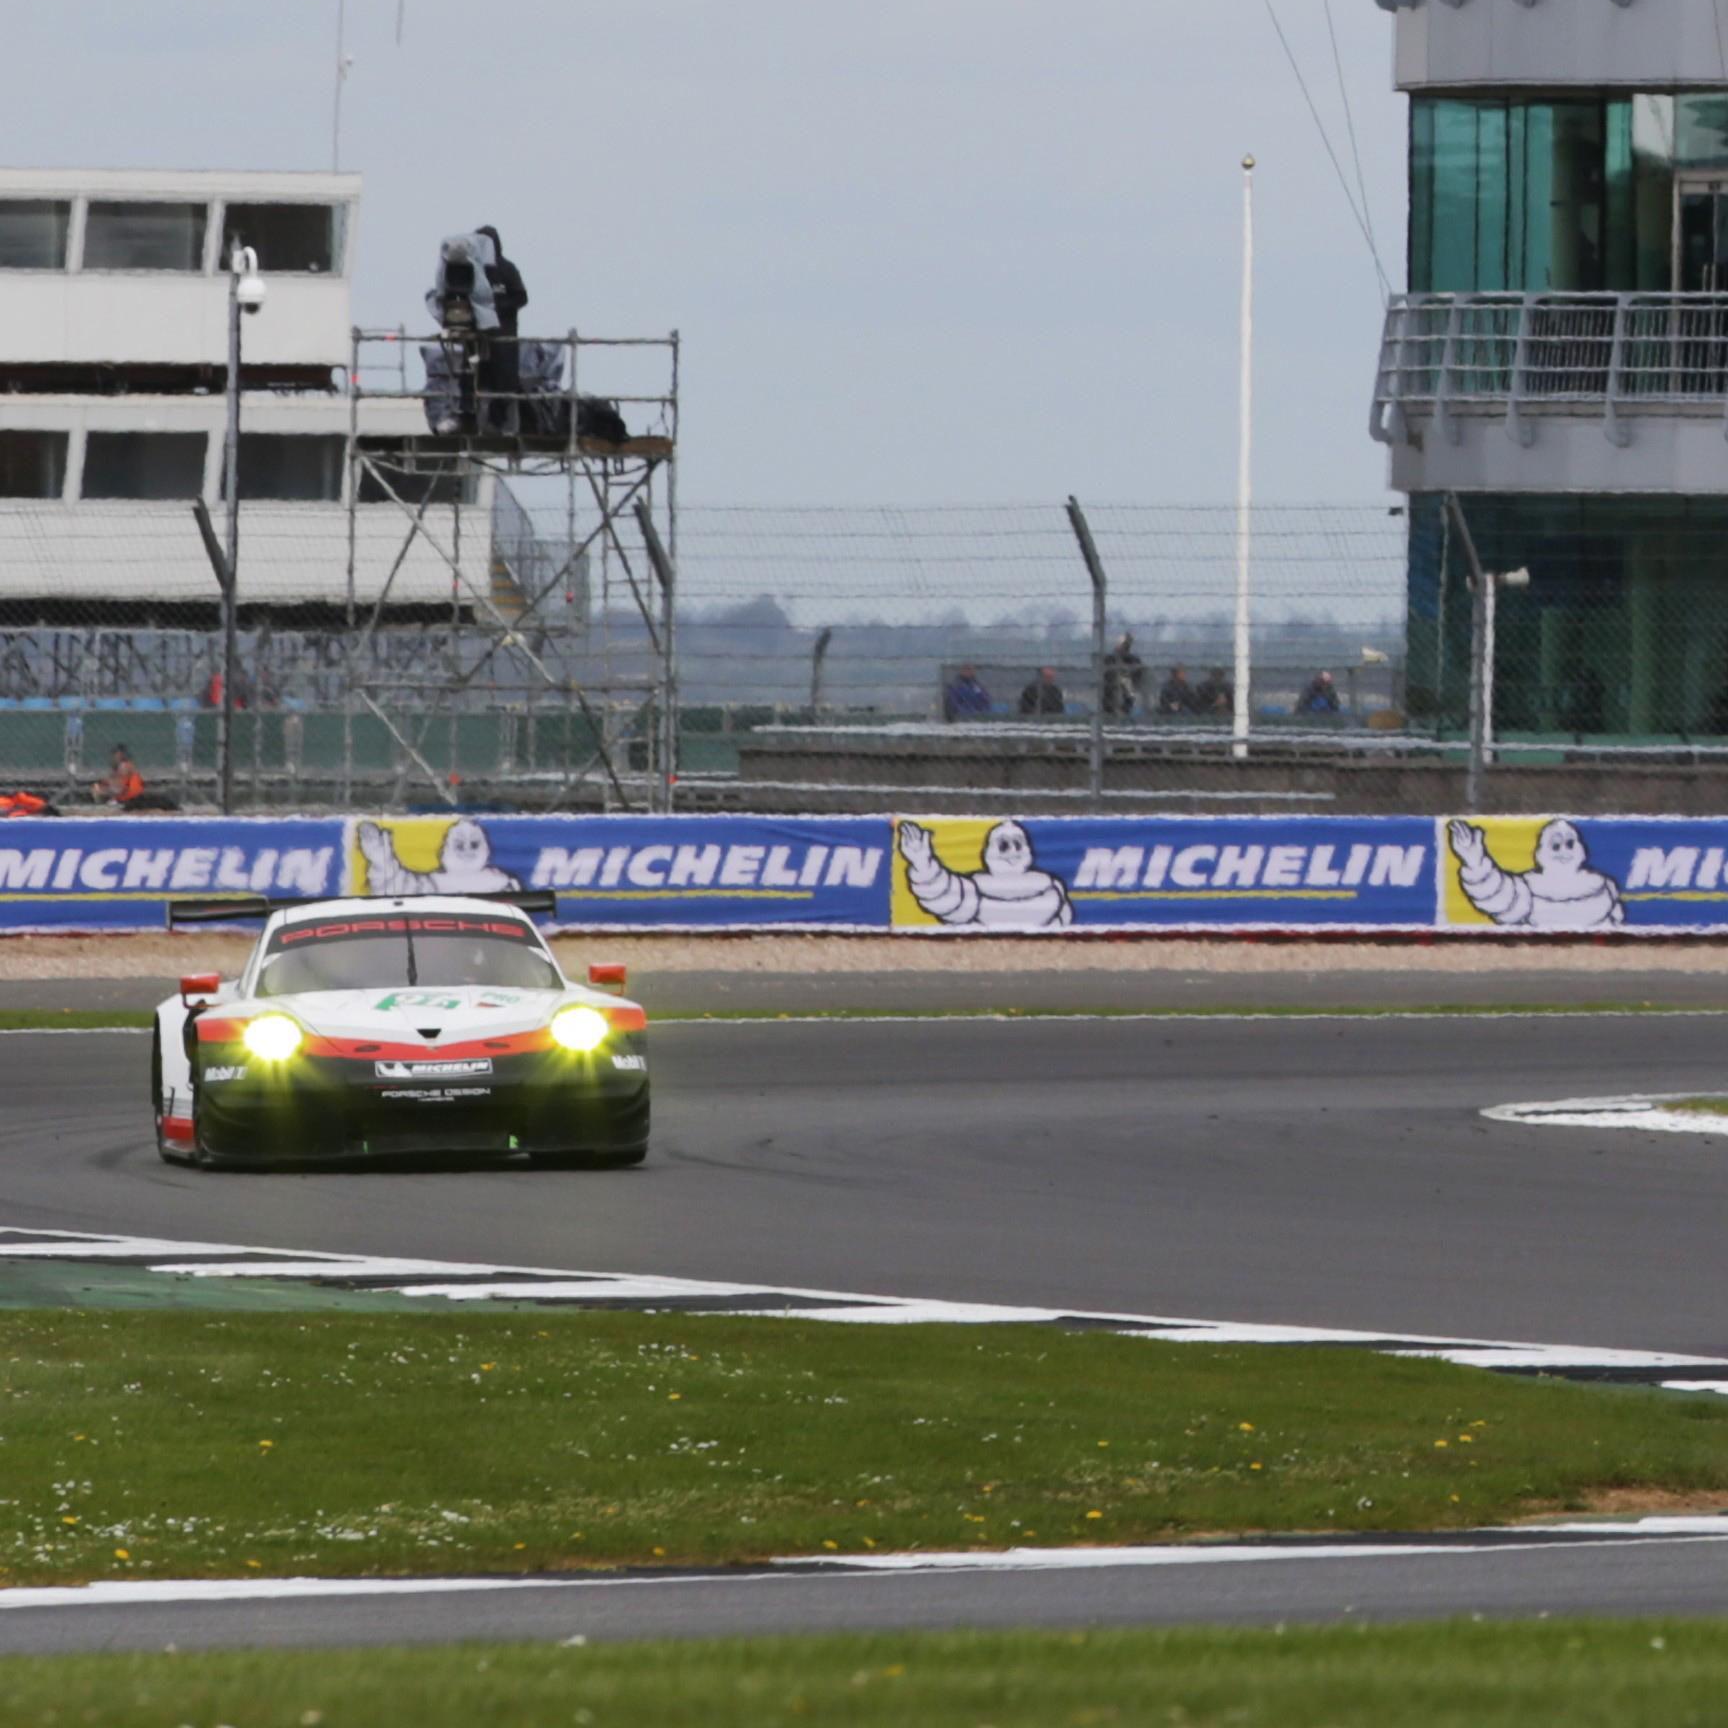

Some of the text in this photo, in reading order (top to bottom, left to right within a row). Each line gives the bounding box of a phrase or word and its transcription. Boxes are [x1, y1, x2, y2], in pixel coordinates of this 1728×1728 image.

[0, 846, 334, 896] MICHELIN
[530, 845, 884, 889] MICHELIN
[1073, 845, 1425, 889] MICHELIN
[280, 920, 525, 944] PORSCHE
[411, 1061, 489, 1073] MICHELIN
